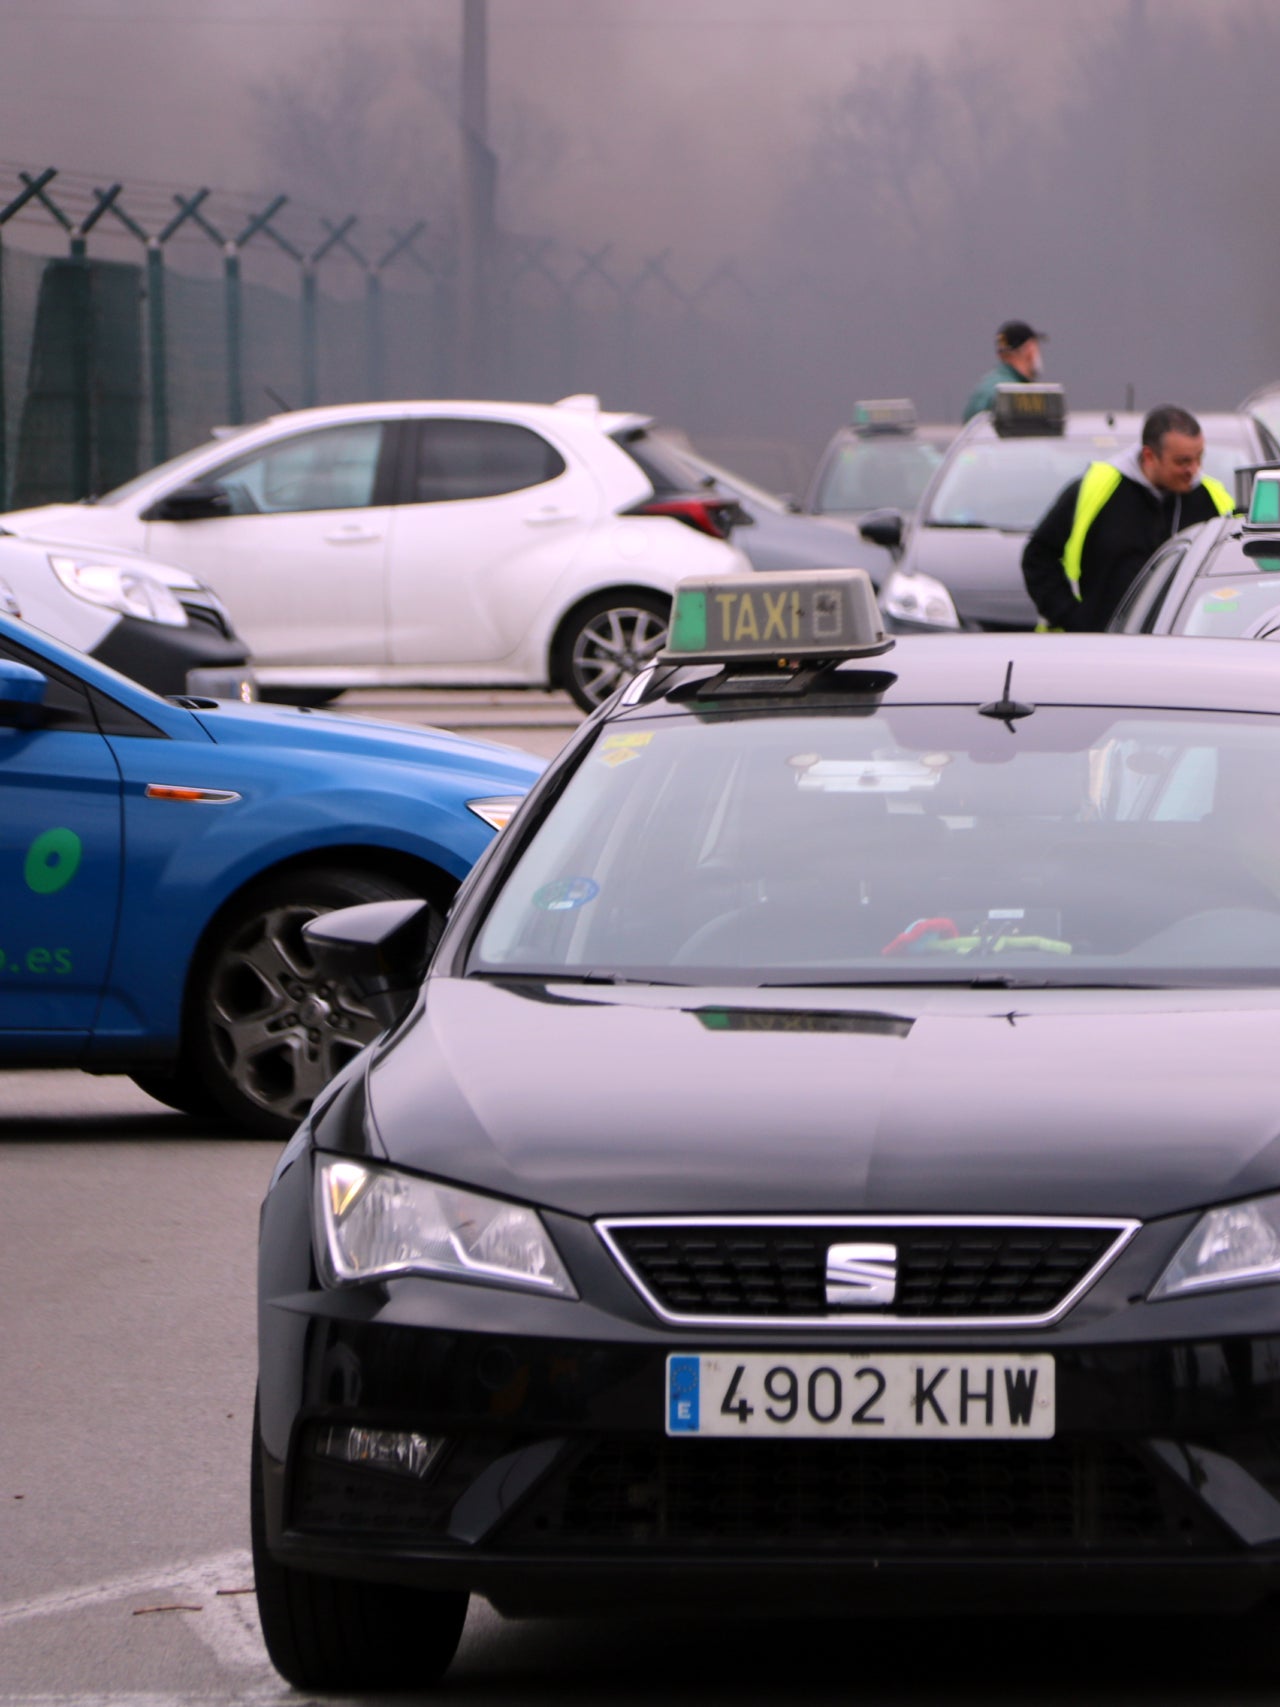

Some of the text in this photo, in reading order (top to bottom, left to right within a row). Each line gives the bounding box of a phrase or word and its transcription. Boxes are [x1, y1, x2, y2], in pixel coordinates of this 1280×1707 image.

[715, 590, 800, 642] TAXI
[720, 1365, 887, 1425] 4902
[914, 1367, 1039, 1427] KHW
